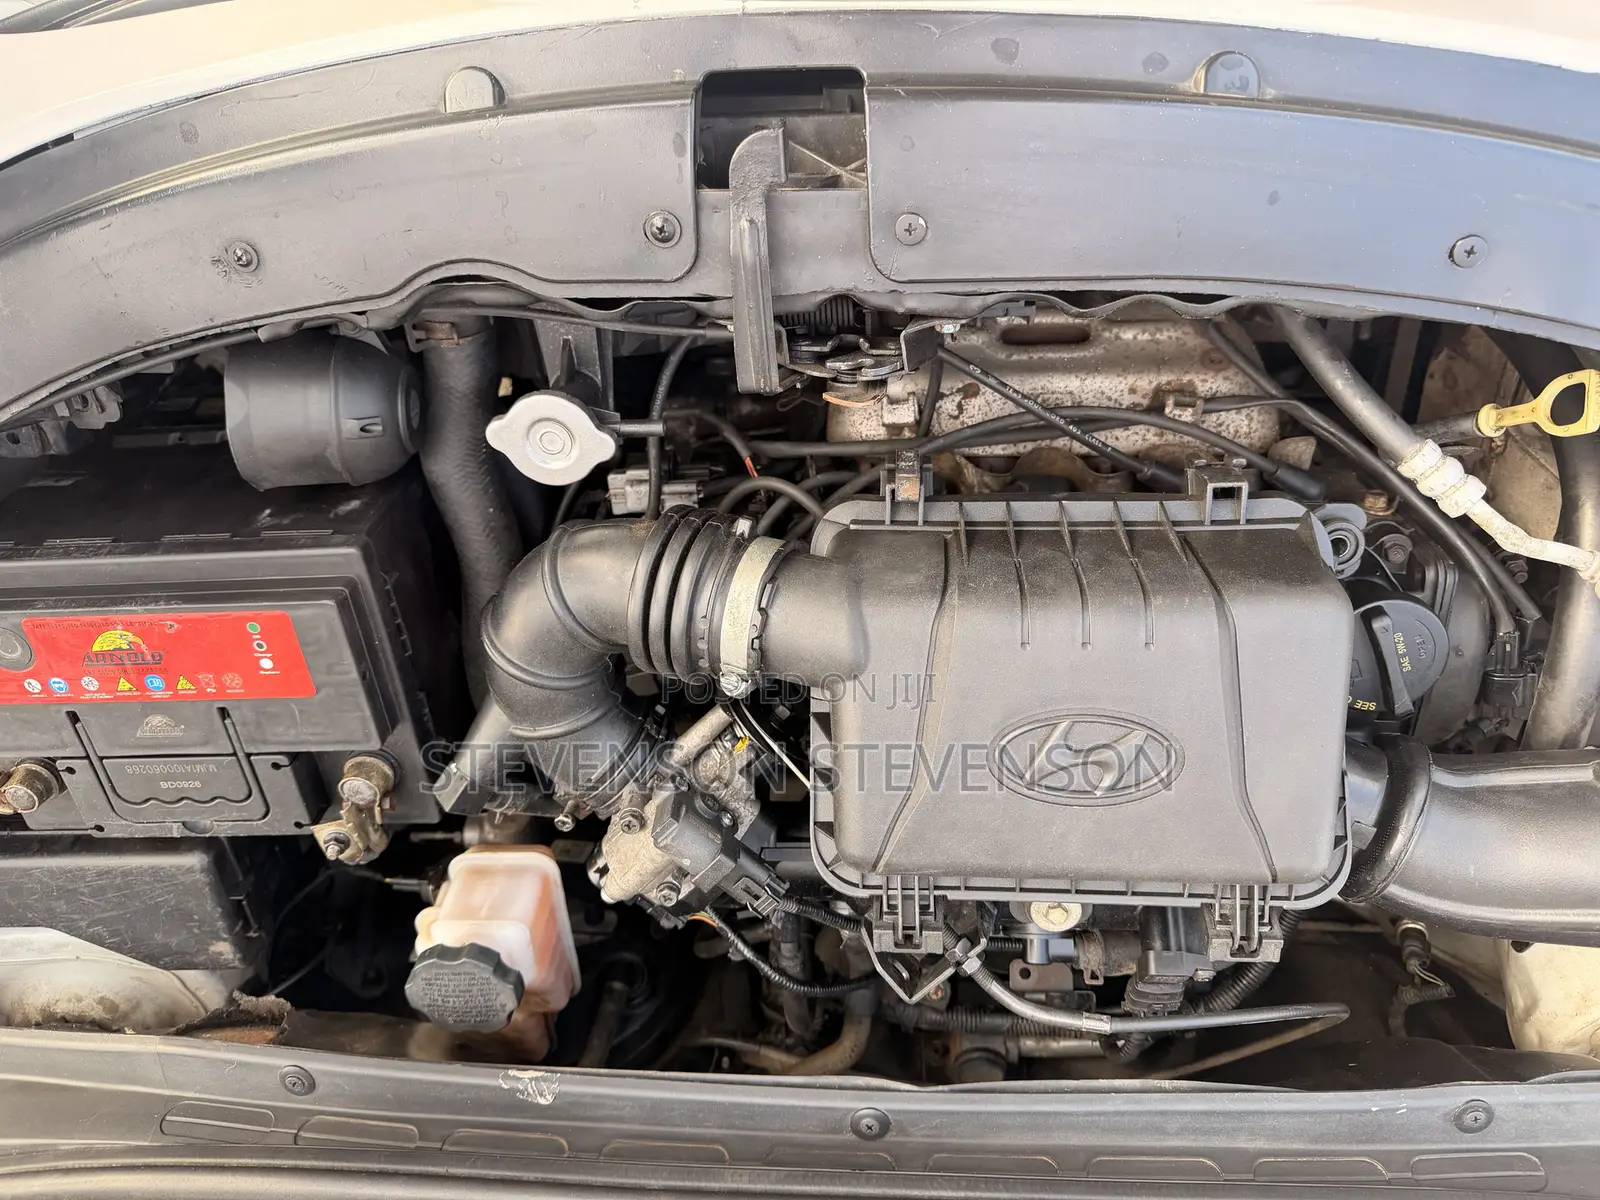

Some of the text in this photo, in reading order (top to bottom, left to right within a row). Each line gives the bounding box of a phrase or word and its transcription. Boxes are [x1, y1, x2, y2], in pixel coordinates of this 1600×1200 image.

[82, 650, 163, 667] ARNOLD
[1394, 632, 1411, 672] SAE 5W-20
[1354, 700, 1377, 711] SEE
